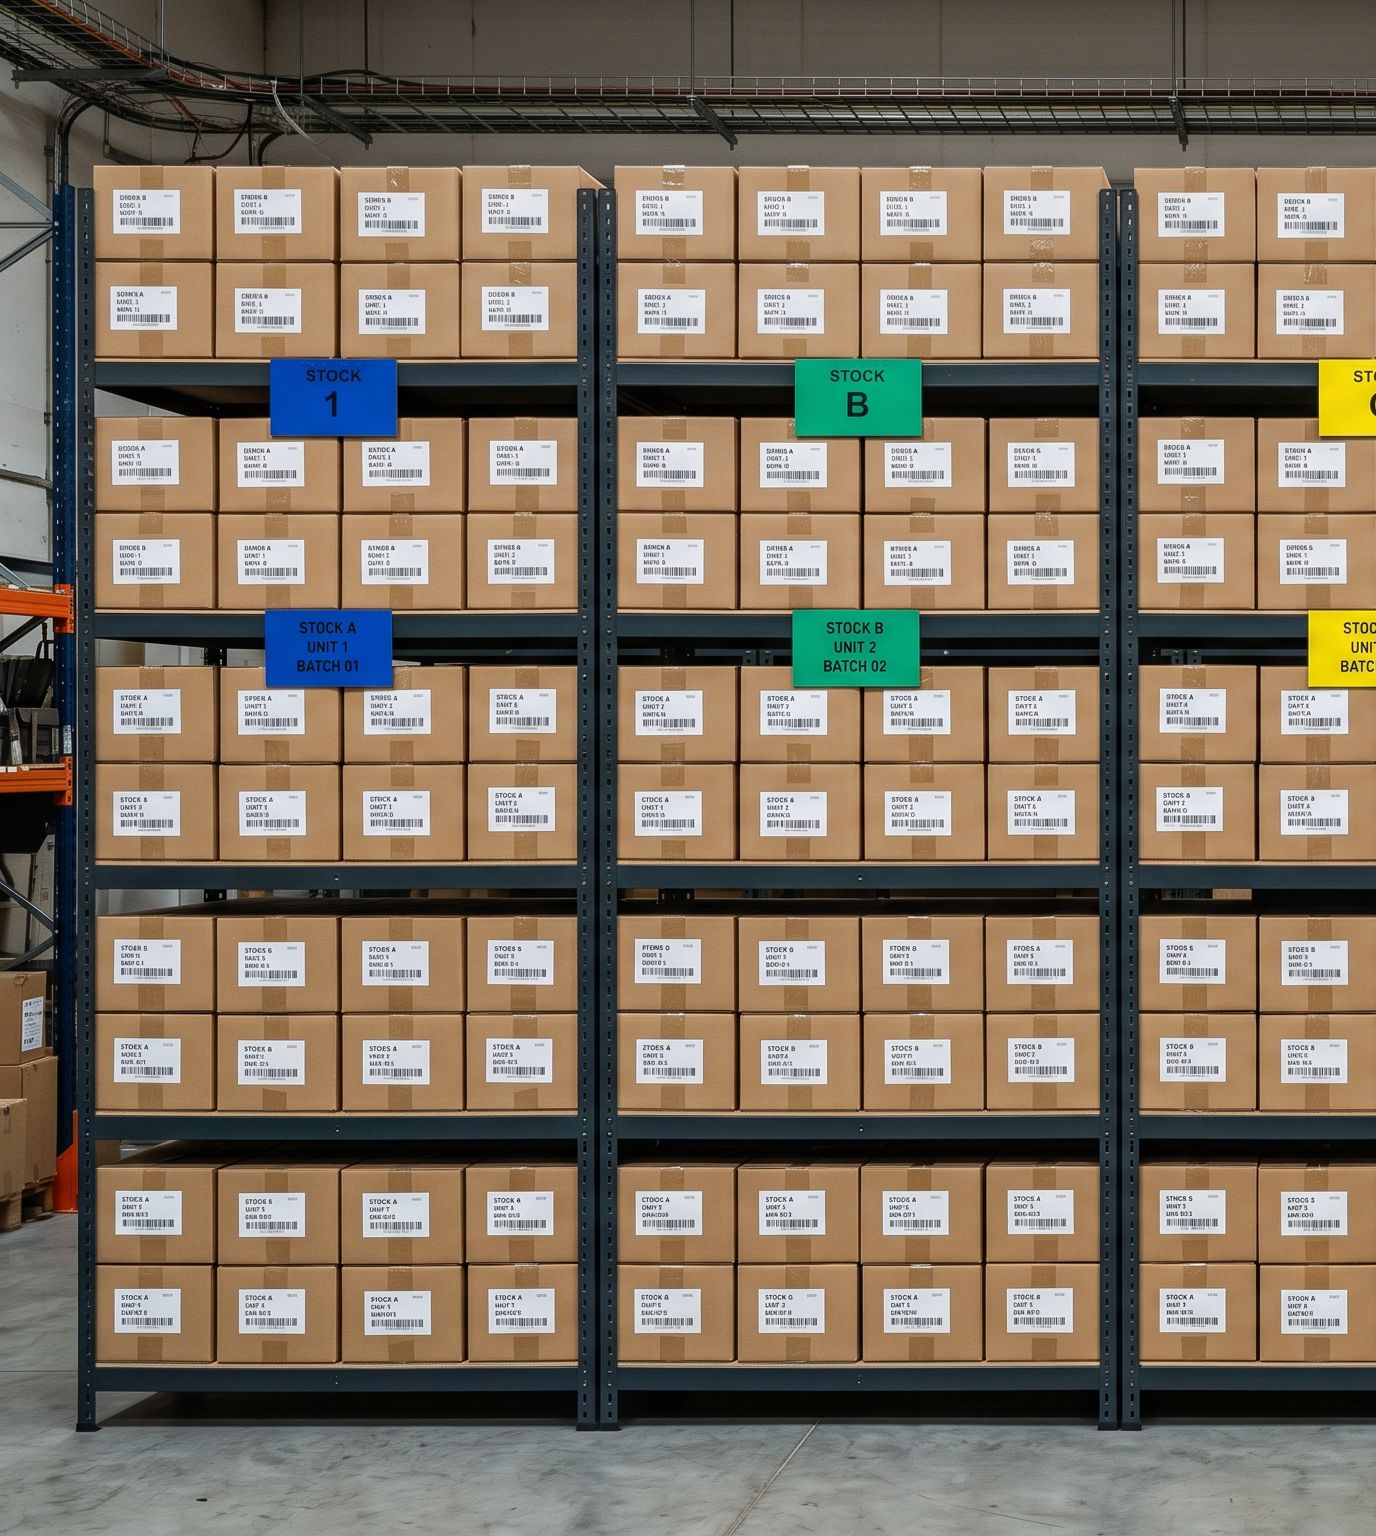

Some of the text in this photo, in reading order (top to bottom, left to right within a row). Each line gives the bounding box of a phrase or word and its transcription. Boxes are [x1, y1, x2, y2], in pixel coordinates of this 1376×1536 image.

[305, 368, 361, 383] STOCK
[830, 369, 885, 383] STOCK
[324, 390, 338, 418] 1
[846, 391, 869, 418] B
[299, 620, 357, 635] STOCK A
[825, 621, 884, 635] STOCK B
[307, 640, 348, 654] UNIT 1
[833, 640, 877, 654] UNIT 2
[296, 659, 359, 673] BATCH 01
[823, 659, 887, 673] BATCH 02
